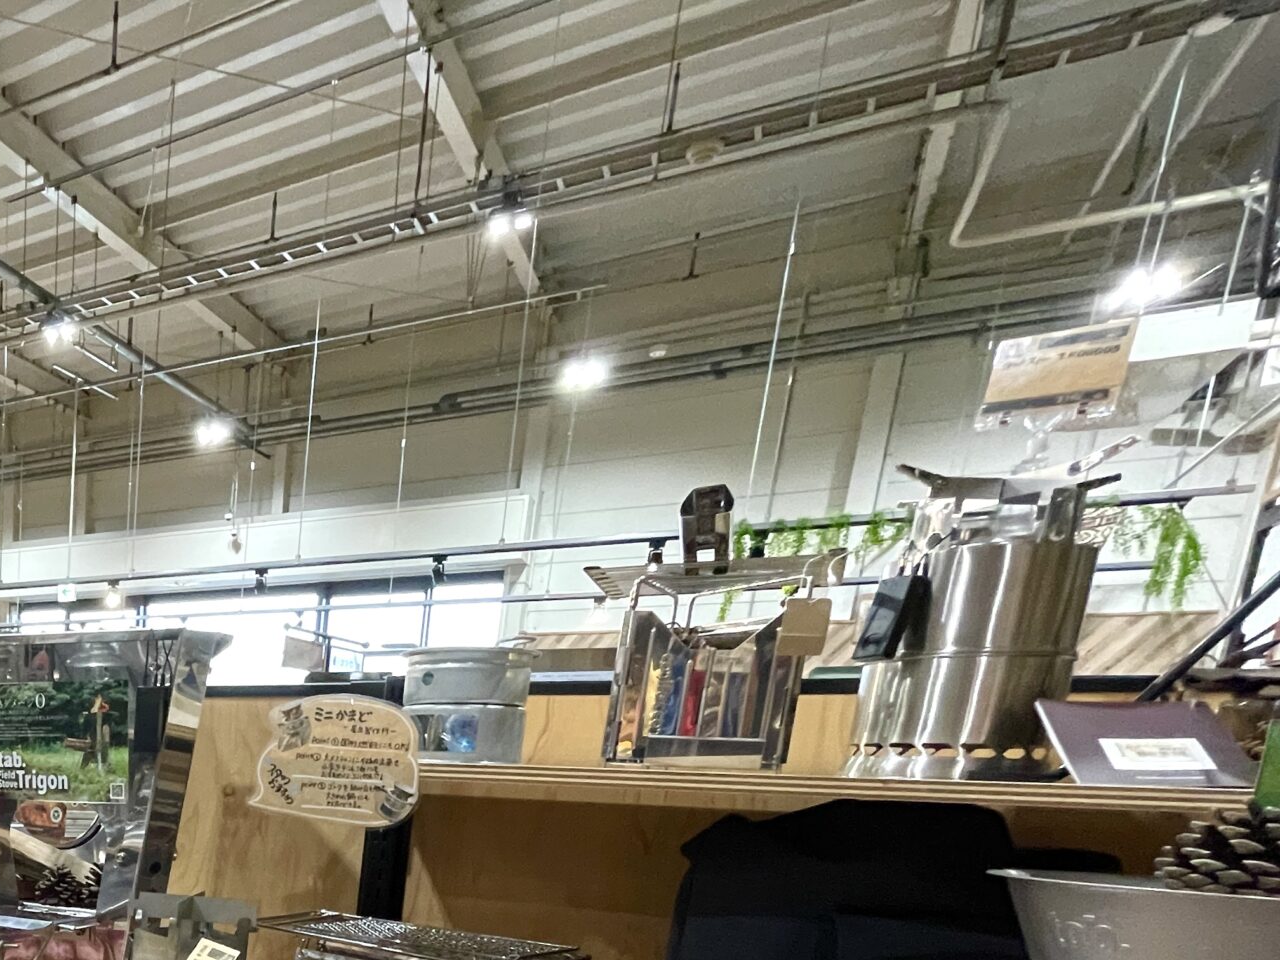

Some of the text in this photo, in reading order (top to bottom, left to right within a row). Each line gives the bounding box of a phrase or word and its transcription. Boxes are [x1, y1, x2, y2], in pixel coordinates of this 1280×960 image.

[313, 706, 373, 722] ミニかまど
[16, 769, 69, 795] Trigon
